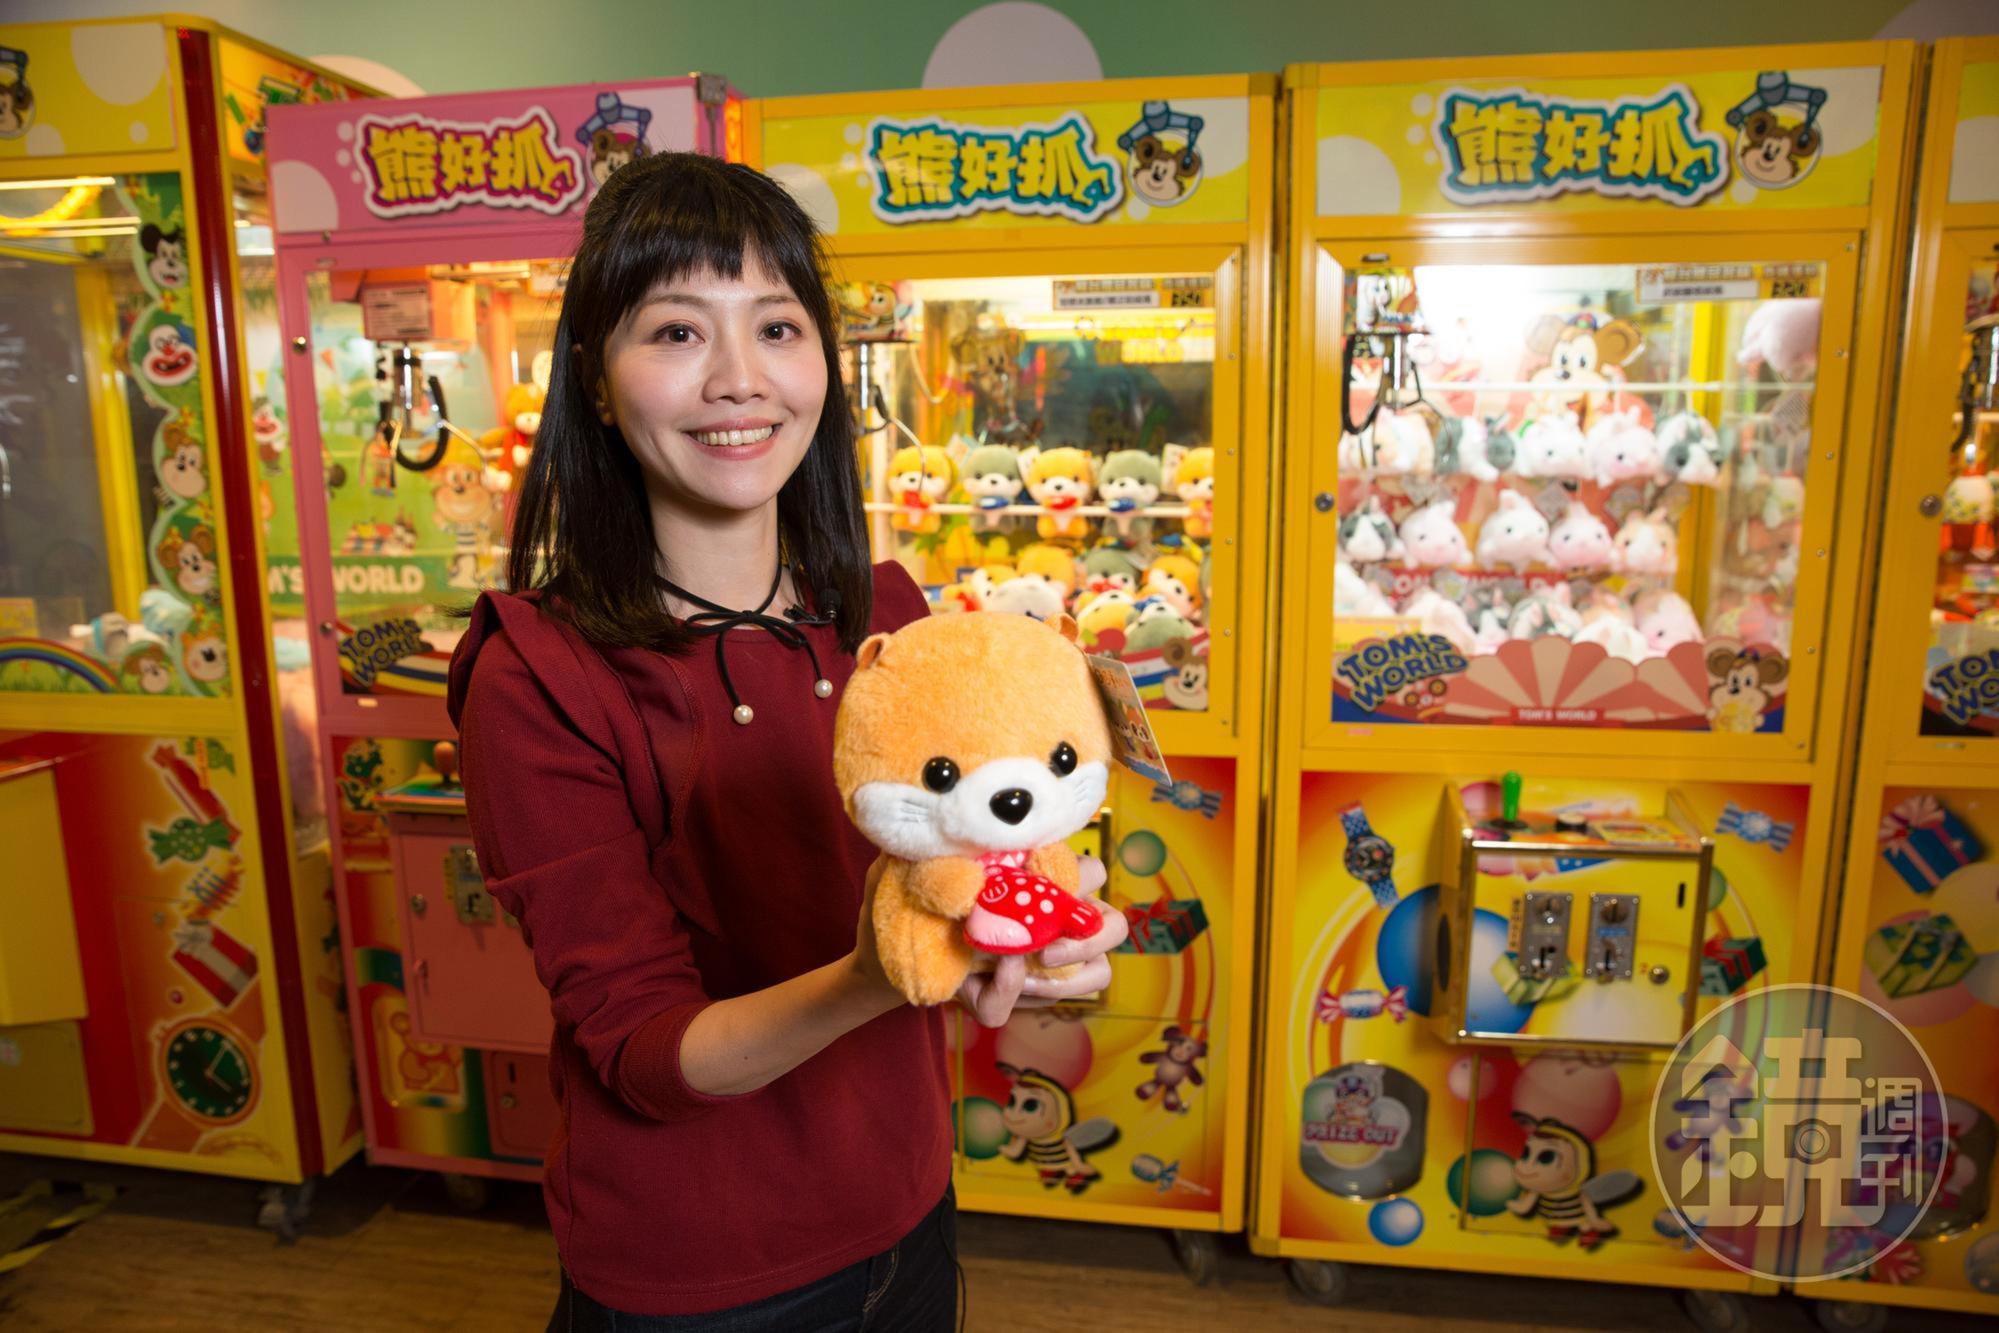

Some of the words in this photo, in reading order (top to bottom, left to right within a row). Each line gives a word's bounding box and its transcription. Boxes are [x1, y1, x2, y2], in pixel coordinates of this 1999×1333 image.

[366, 118, 576, 203] 熊好抓
[876, 125, 1113, 208] 熊好抓
[1448, 98, 1716, 190] 熊好抓
[1354, 654, 1469, 713] WORLD
[1556, 708, 1599, 722] WORLD
[1304, 1121, 1359, 1143] PRIZE
[1361, 1123, 1400, 1147] OUT
